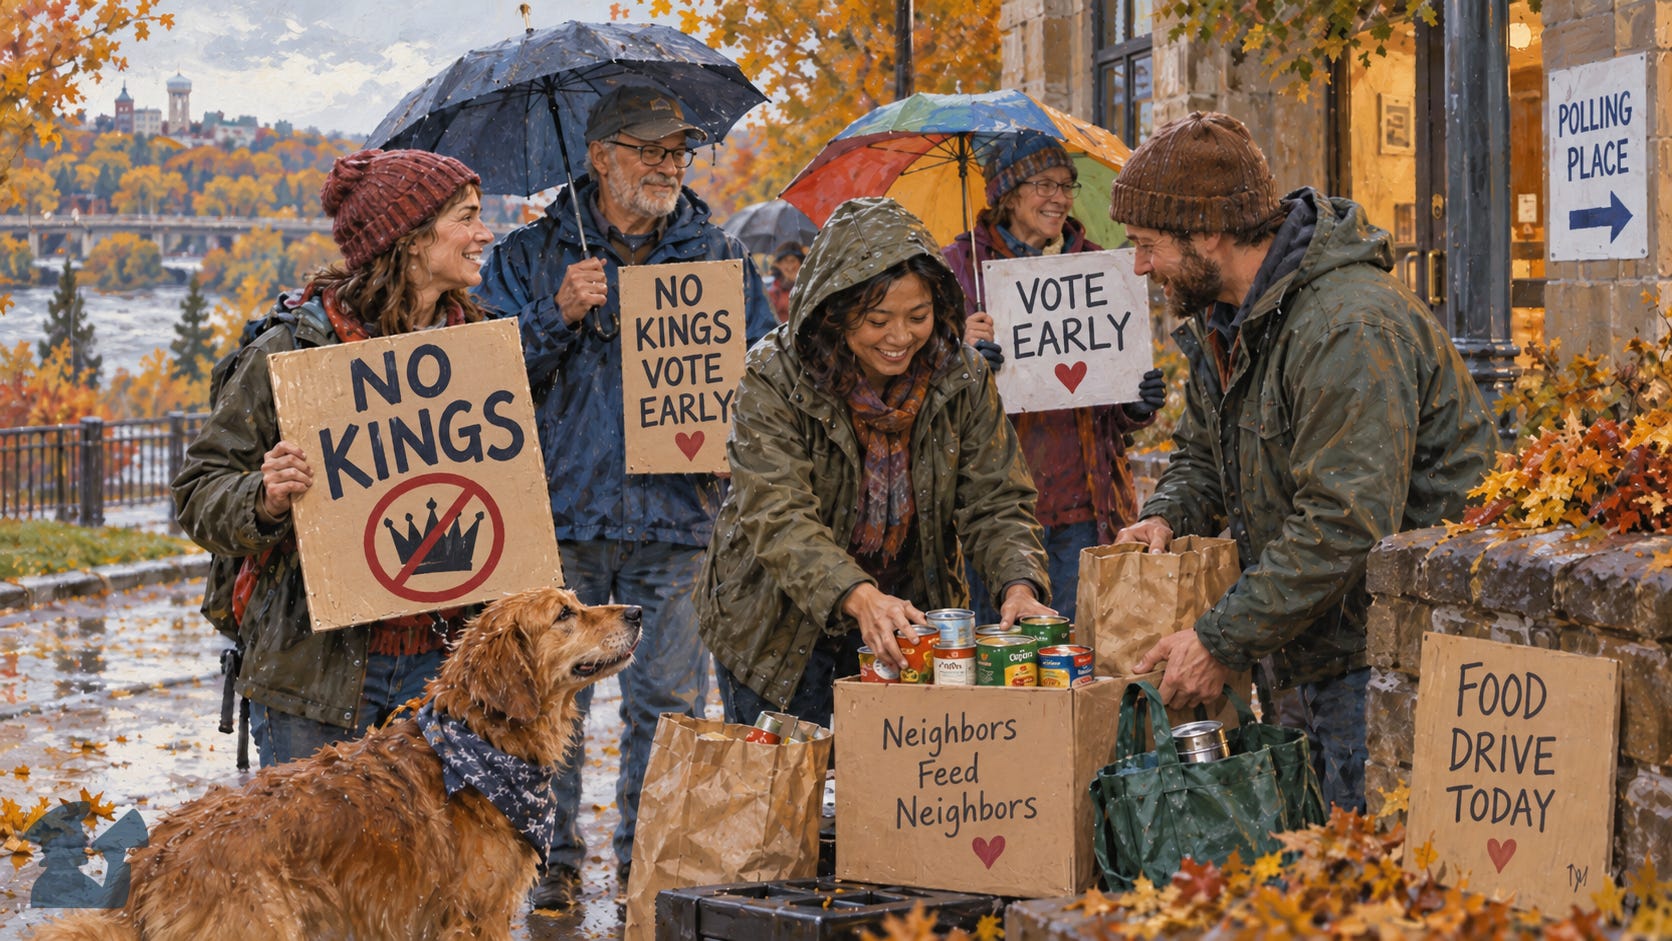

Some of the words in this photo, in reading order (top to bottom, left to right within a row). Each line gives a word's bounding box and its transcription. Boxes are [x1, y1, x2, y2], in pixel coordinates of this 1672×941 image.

[1558, 90, 1633, 138] POLLING
[1567, 138, 1629, 182] PLACE
[654, 273, 704, 311] NO
[1015, 271, 1108, 314] VOTE
[635, 309, 732, 352] KINGS
[1012, 311, 1132, 360] EARLY
[350, 343, 453, 415] NO
[641, 352, 724, 390] VOTE
[639, 388, 735, 428] EARLY
[318, 389, 525, 500] KINGS
[1456, 660, 1548, 720] FOOD
[882, 712, 1017, 757] Neighbors
[1448, 727, 1557, 776] DRIVE
[918, 751, 979, 789] Feed
[896, 790, 1038, 839] Neighbors
[1445, 784, 1557, 834] TODAY
